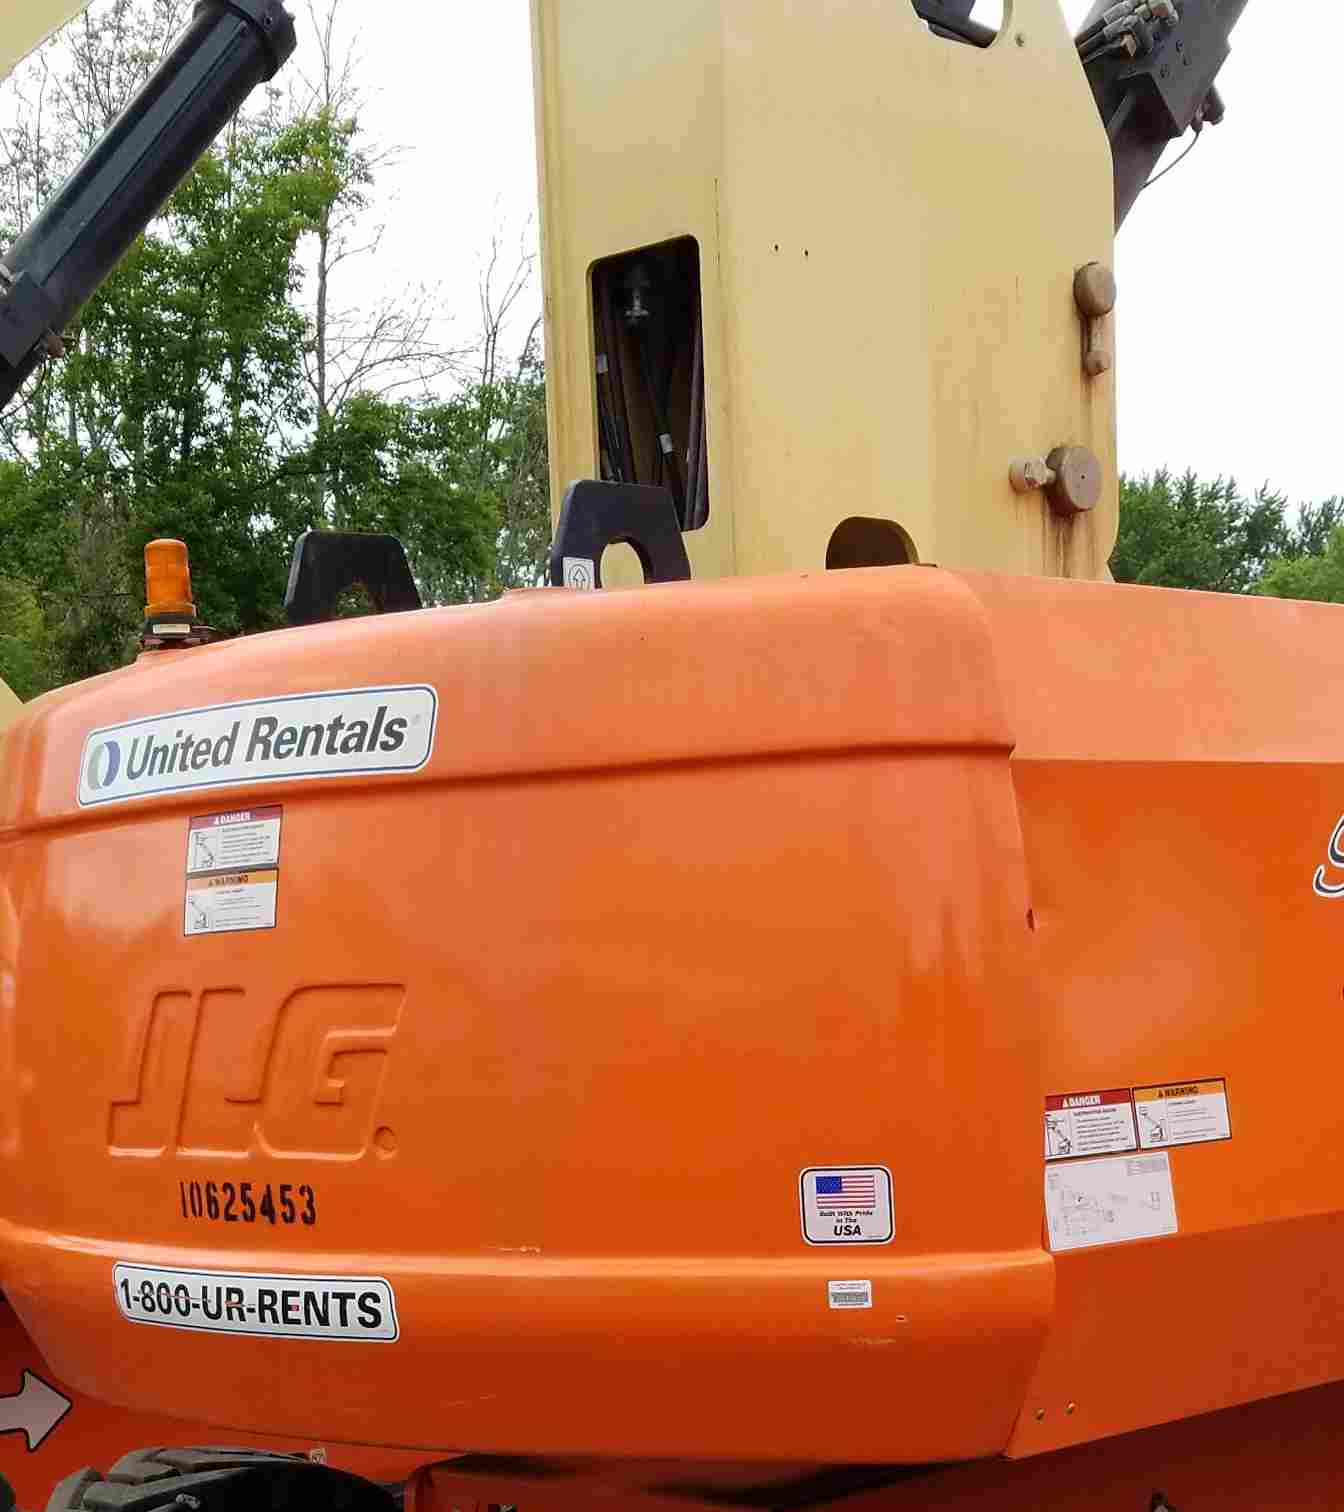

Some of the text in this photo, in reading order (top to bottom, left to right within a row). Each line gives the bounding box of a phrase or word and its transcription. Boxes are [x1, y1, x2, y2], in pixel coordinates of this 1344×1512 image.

[126, 704, 409, 781] United Rentals
[107, 983, 406, 1160] JLG
[178, 1181, 317, 1226] 10625453
[833, 1225, 862, 1237] USA
[119, 1276, 383, 1330] 1-800-UR-RENTS
